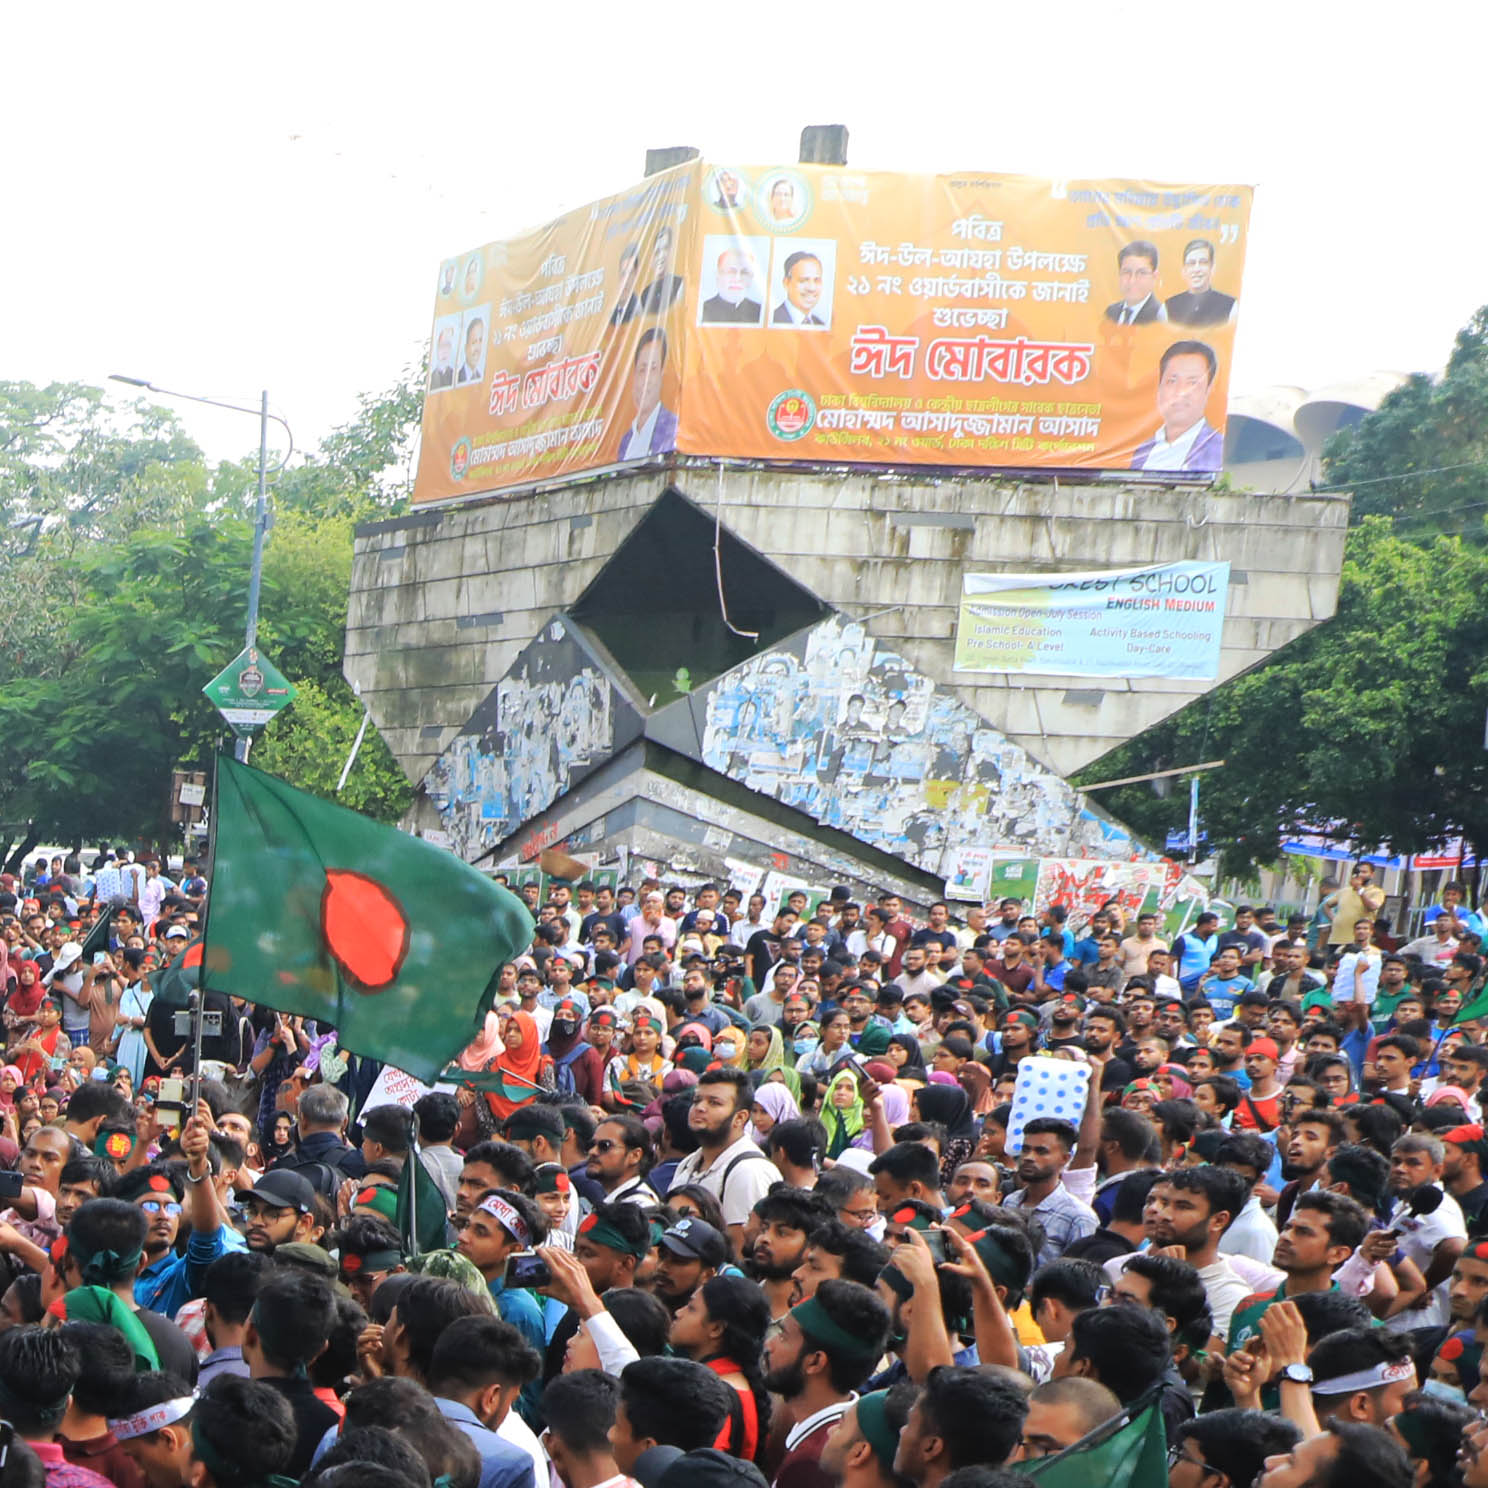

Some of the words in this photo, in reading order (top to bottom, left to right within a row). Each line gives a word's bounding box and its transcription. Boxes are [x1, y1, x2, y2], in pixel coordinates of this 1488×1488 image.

[951, 217, 1003, 242] পবিত্র
[859, 241, 1002, 270] ঈদ-উল-আযহা
[1008, 246, 1087, 274] উপলক্ষে
[847, 274, 870, 297] ২১
[878, 274, 903, 297] নং
[909, 272, 1025, 301] ওয়ার্ডবাসীকে
[1032, 276, 1090, 304] জানাই
[933, 306, 1008, 330] শুভেচ্ছা
[850, 325, 919, 379] ঈদ
[925, 334, 1095, 386] মোবারক
[1039, 415, 1102, 437] আসাদ
[1130, 573, 1217, 594] SCHOOL
[1106, 596, 1160, 611] ENGLISH
[1067, 608, 1102, 621] Session
[974, 624, 1009, 635] Islamic
[1012, 624, 1062, 637] Education
[1090, 627, 1127, 640] Activity
[1130, 628, 1160, 639] Based
[1163, 629, 1212, 642] Schooling
[967, 638, 985, 649] Pre
[1037, 641, 1064, 652] Level
[1127, 642, 1172, 655] Day-Care
